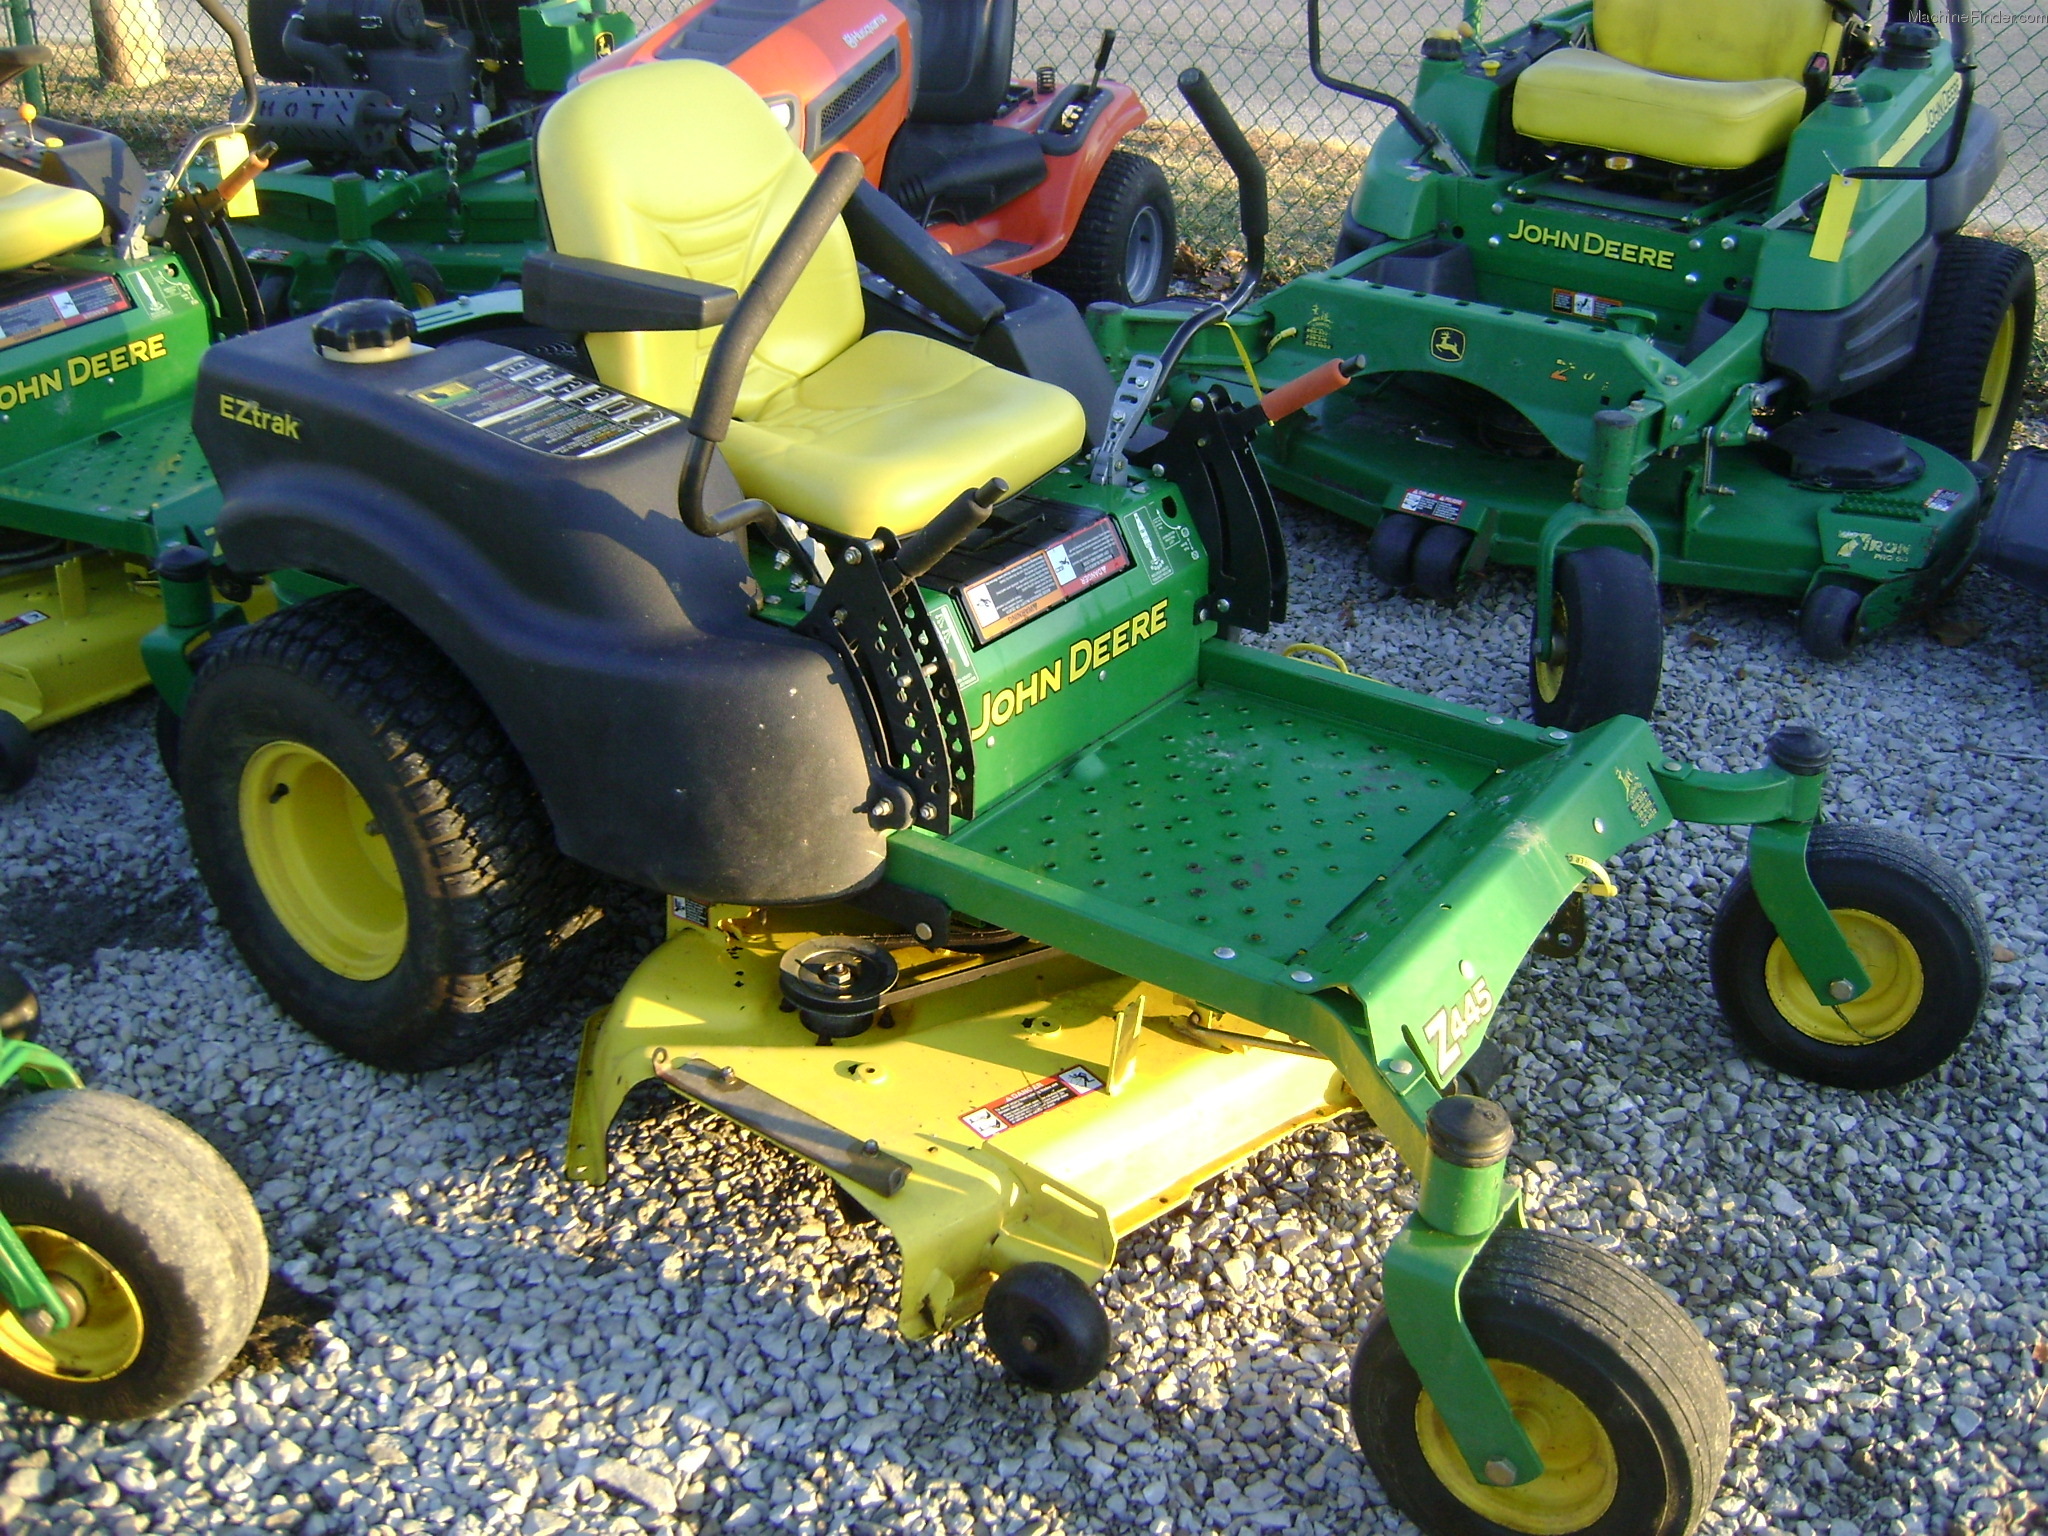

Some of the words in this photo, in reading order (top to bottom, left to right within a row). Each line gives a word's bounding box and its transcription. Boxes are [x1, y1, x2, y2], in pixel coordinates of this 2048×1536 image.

[260, 100, 325, 120] HOT
[1508, 219, 1580, 251] JOHN
[1583, 231, 1675, 270] DEERE
[0, 367, 63, 411] OHN
[67, 333, 168, 387] DEERE
[220, 393, 300, 440] EZtrak
[971, 657, 1063, 742] JOHN
[1069, 597, 1169, 685] DEERE
[1422, 974, 1494, 1081] Z445
